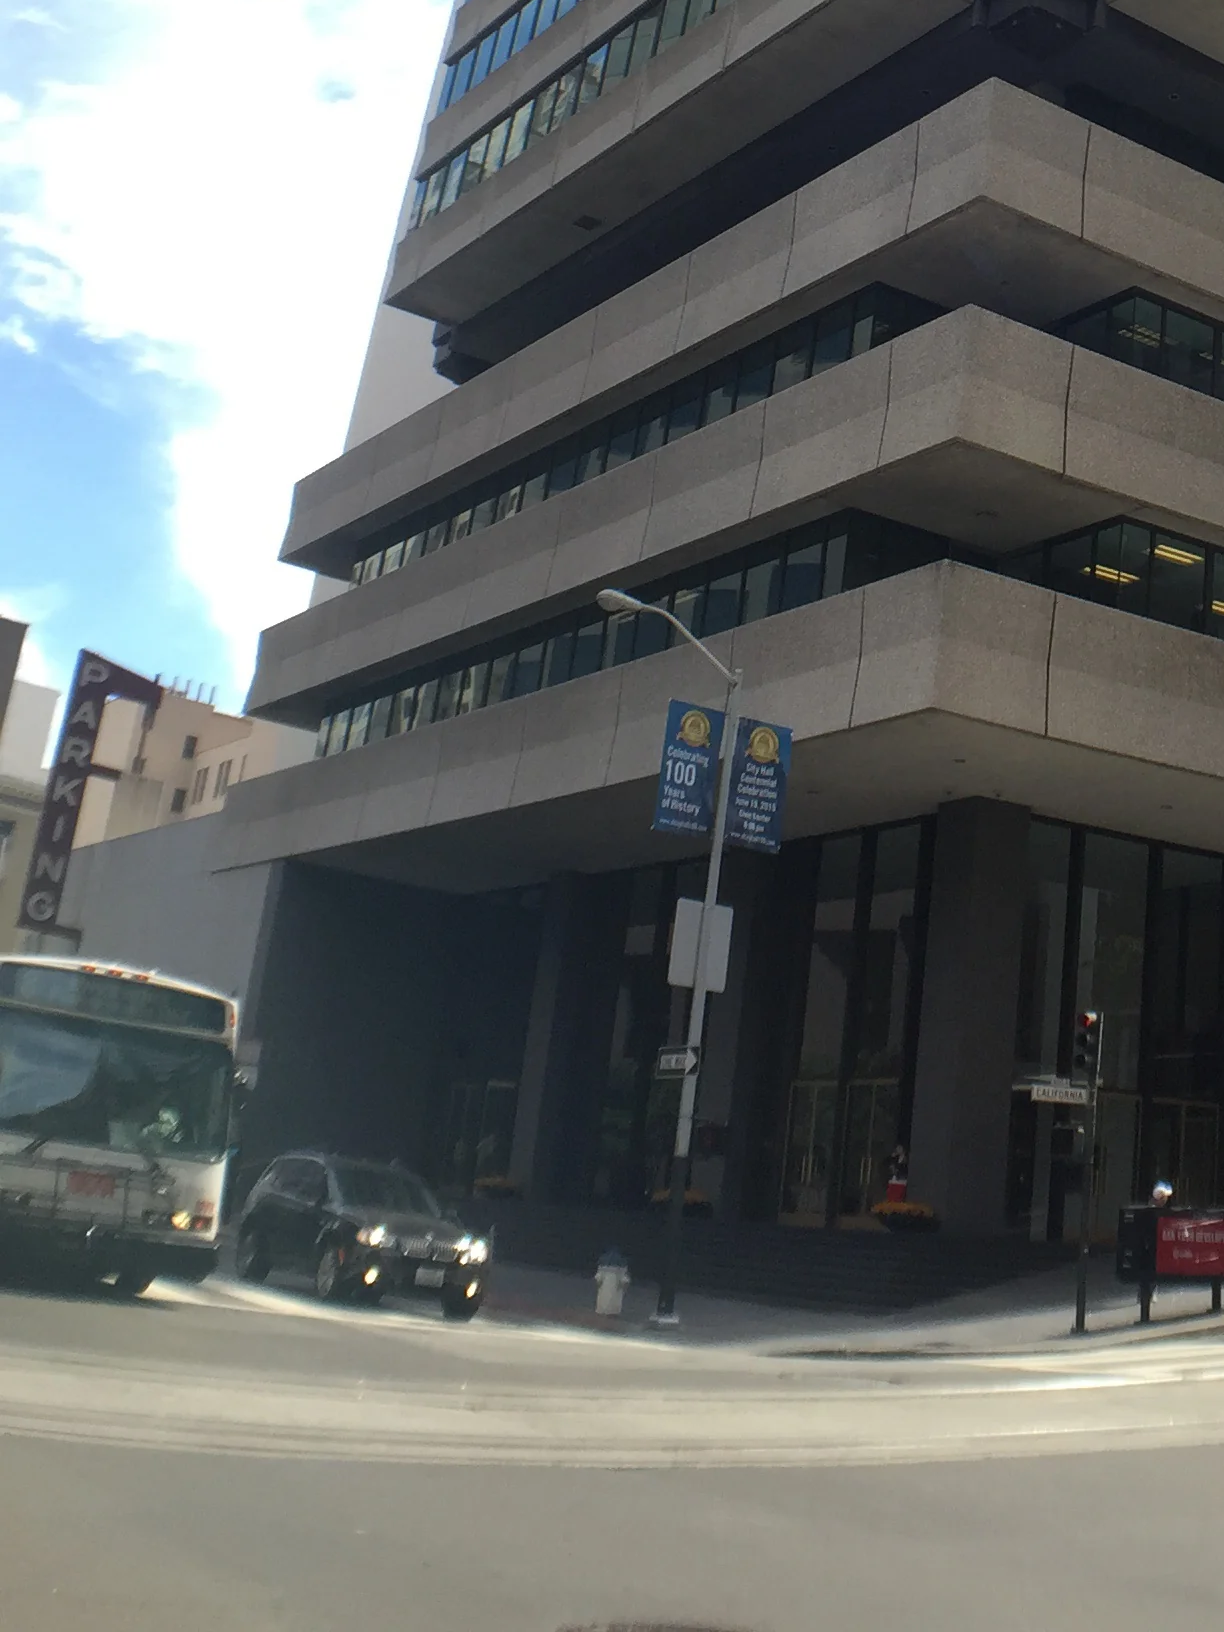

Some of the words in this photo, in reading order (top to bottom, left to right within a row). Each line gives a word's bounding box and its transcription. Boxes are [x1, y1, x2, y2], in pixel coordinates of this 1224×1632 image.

[667, 745, 709, 768] Celebrating
[666, 759, 696, 786] 100
[746, 762, 760, 775] City
[760, 765, 774, 776] Hall
[740, 772, 777, 788] Centennial
[26, 659, 110, 921] PARKING
[664, 785, 685, 799] Years
[737, 783, 777, 799] Celebration
[661, 798, 671, 808] of
[671, 799, 701, 816] History
[1036, 1087, 1083, 1101] CALIFORNIA
